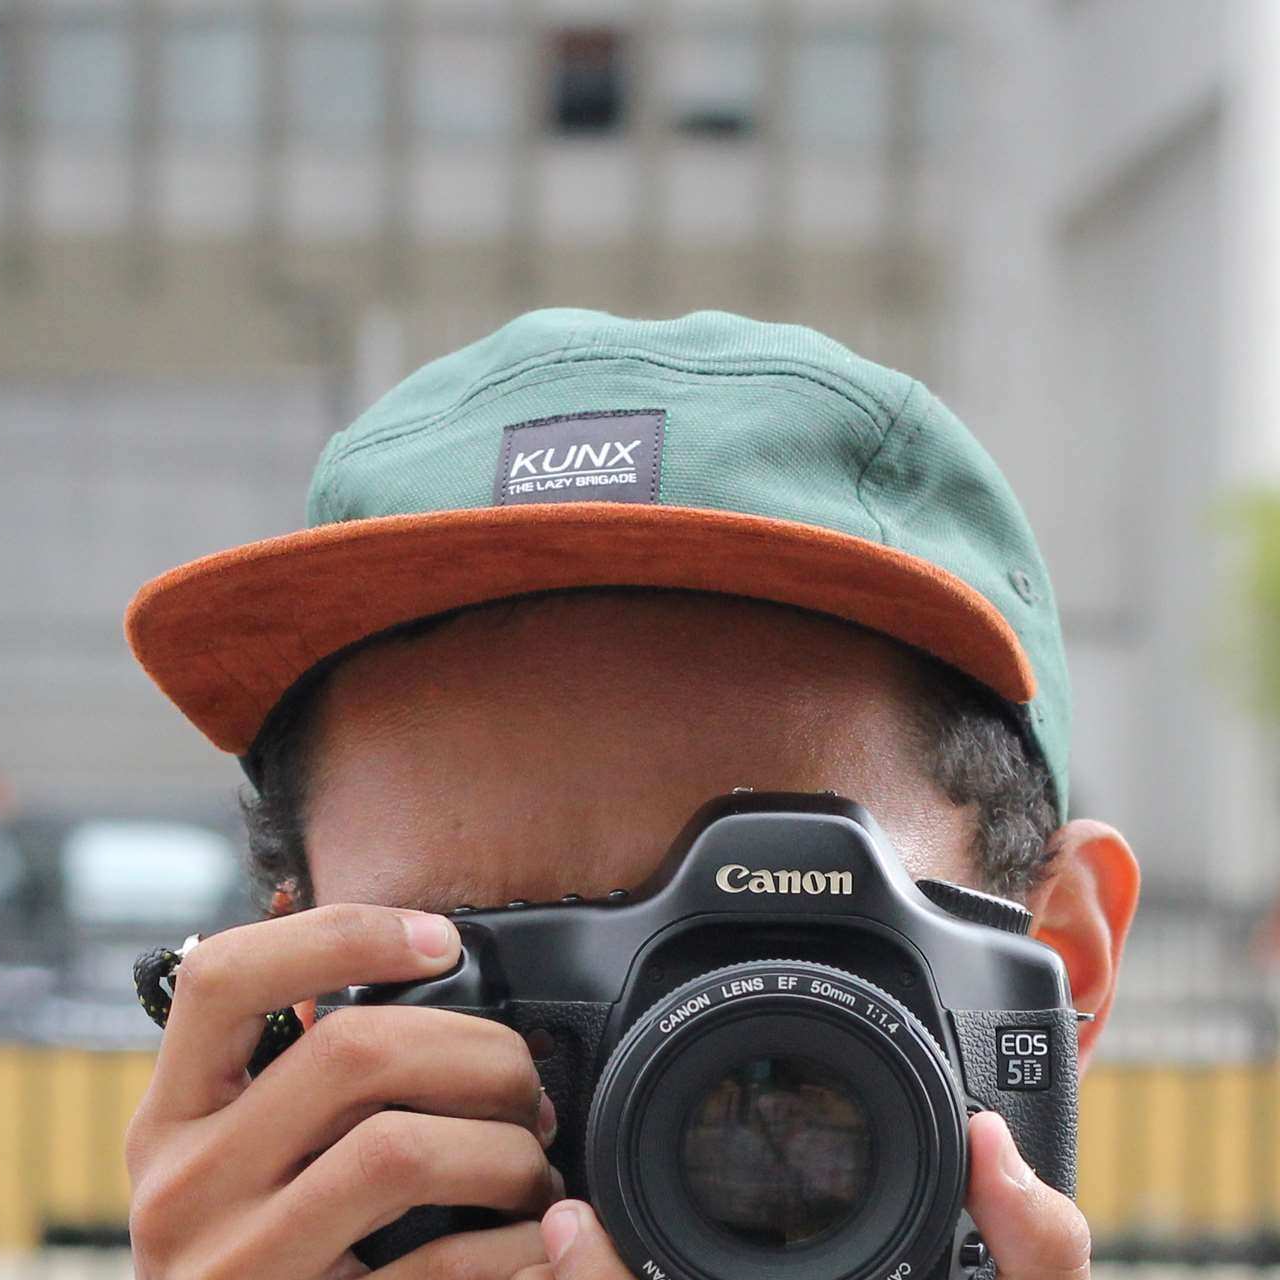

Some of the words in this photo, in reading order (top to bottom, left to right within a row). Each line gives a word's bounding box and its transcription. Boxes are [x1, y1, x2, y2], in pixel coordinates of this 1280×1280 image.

[510, 440, 641, 478] KUNX
[508, 483, 534, 495] THE
[537, 478, 573, 491] LAZY
[575, 473, 637, 486] BRIGADE
[715, 864, 853, 895] Canon
[659, 993, 712, 1034] CANON
[721, 976, 765, 998] LENS
[777, 976, 798, 990] EF
[810, 981, 857, 1007] 50mm
[865, 1003, 901, 1035] 1:1.4
[1001, 1034, 1048, 1055] EOS
[1007, 1060, 1042, 1085] 5D
